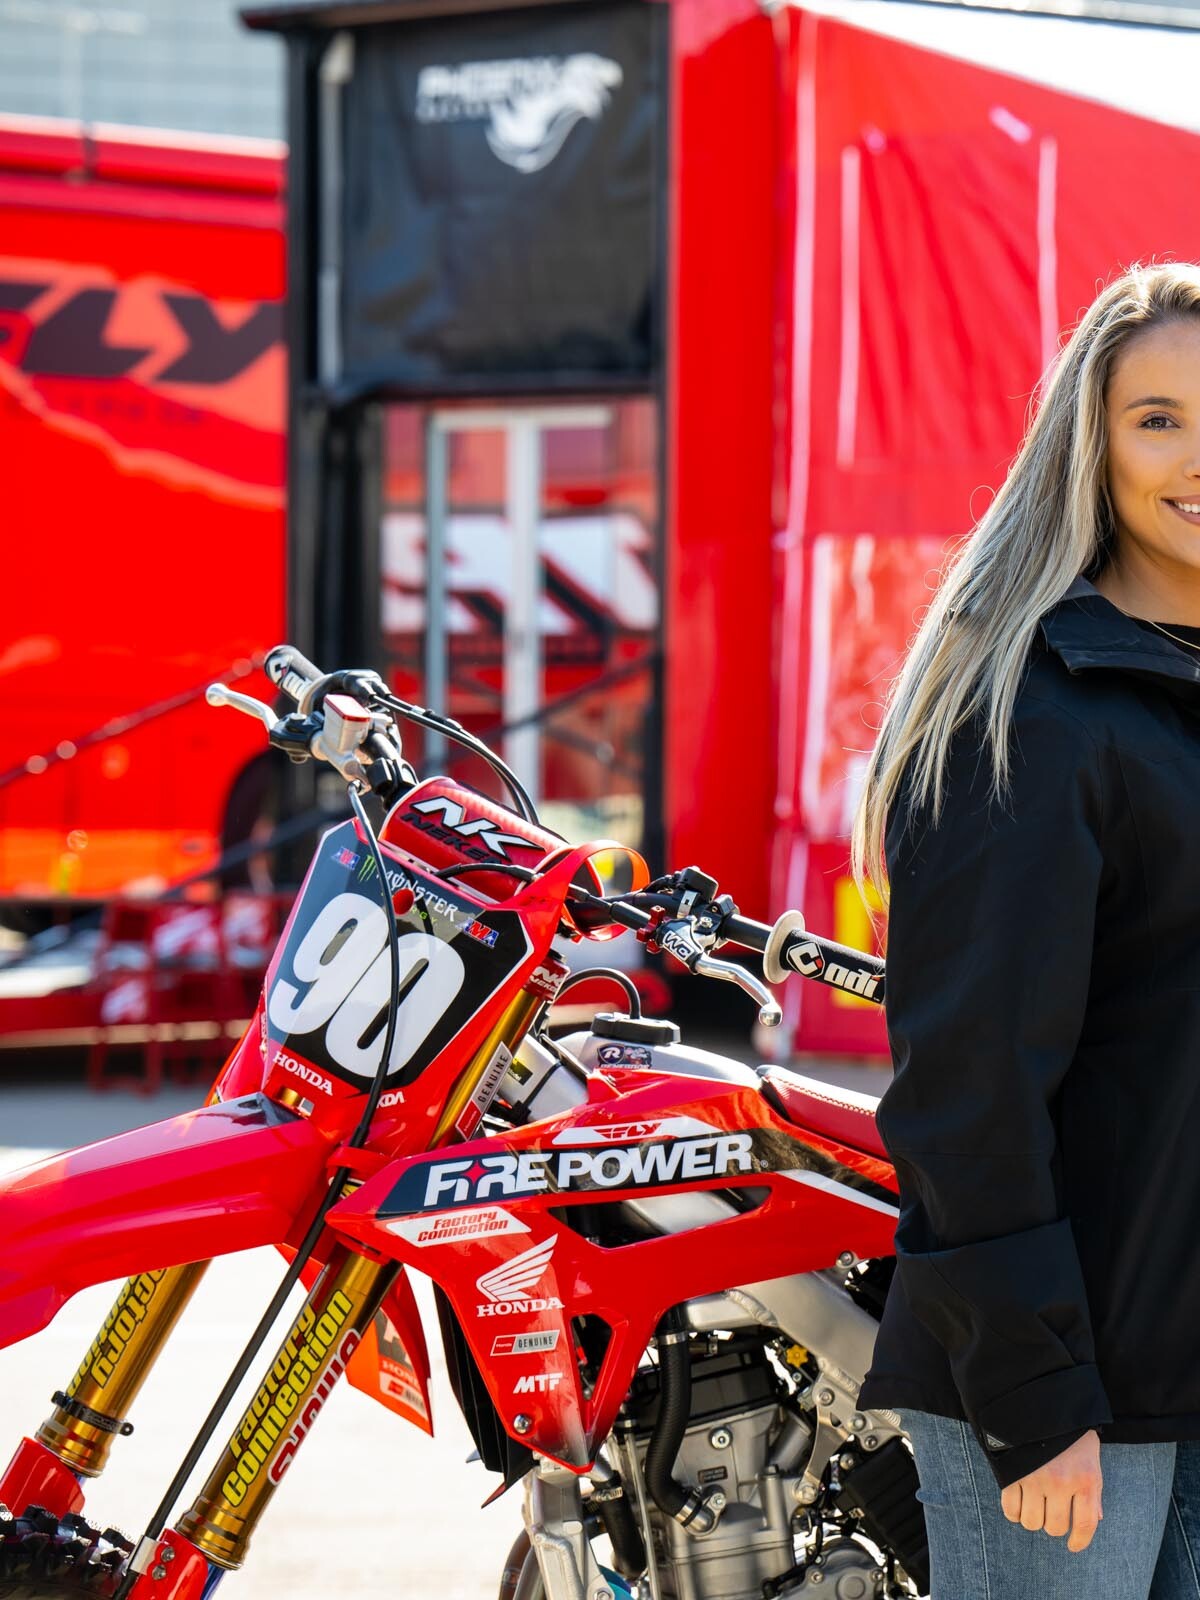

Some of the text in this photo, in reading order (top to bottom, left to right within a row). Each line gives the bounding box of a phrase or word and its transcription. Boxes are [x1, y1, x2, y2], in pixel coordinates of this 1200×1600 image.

[456, 917, 500, 950] AMA
[269, 893, 465, 1078] 90
[273, 1051, 333, 1096] HONDA
[477, 1054, 508, 1103] GENUINE
[610, 1122, 662, 1139] FLY
[557, 1133, 754, 1188] POWER
[417, 1219, 509, 1242] Connection
[433, 1211, 498, 1231] Factory
[477, 1297, 565, 1317] HONDA
[518, 1335, 553, 1348] GENUINE
[229, 1303, 317, 1459] Factory
[513, 1372, 563, 1394] MTF
[221, 1289, 353, 1508] Connection
